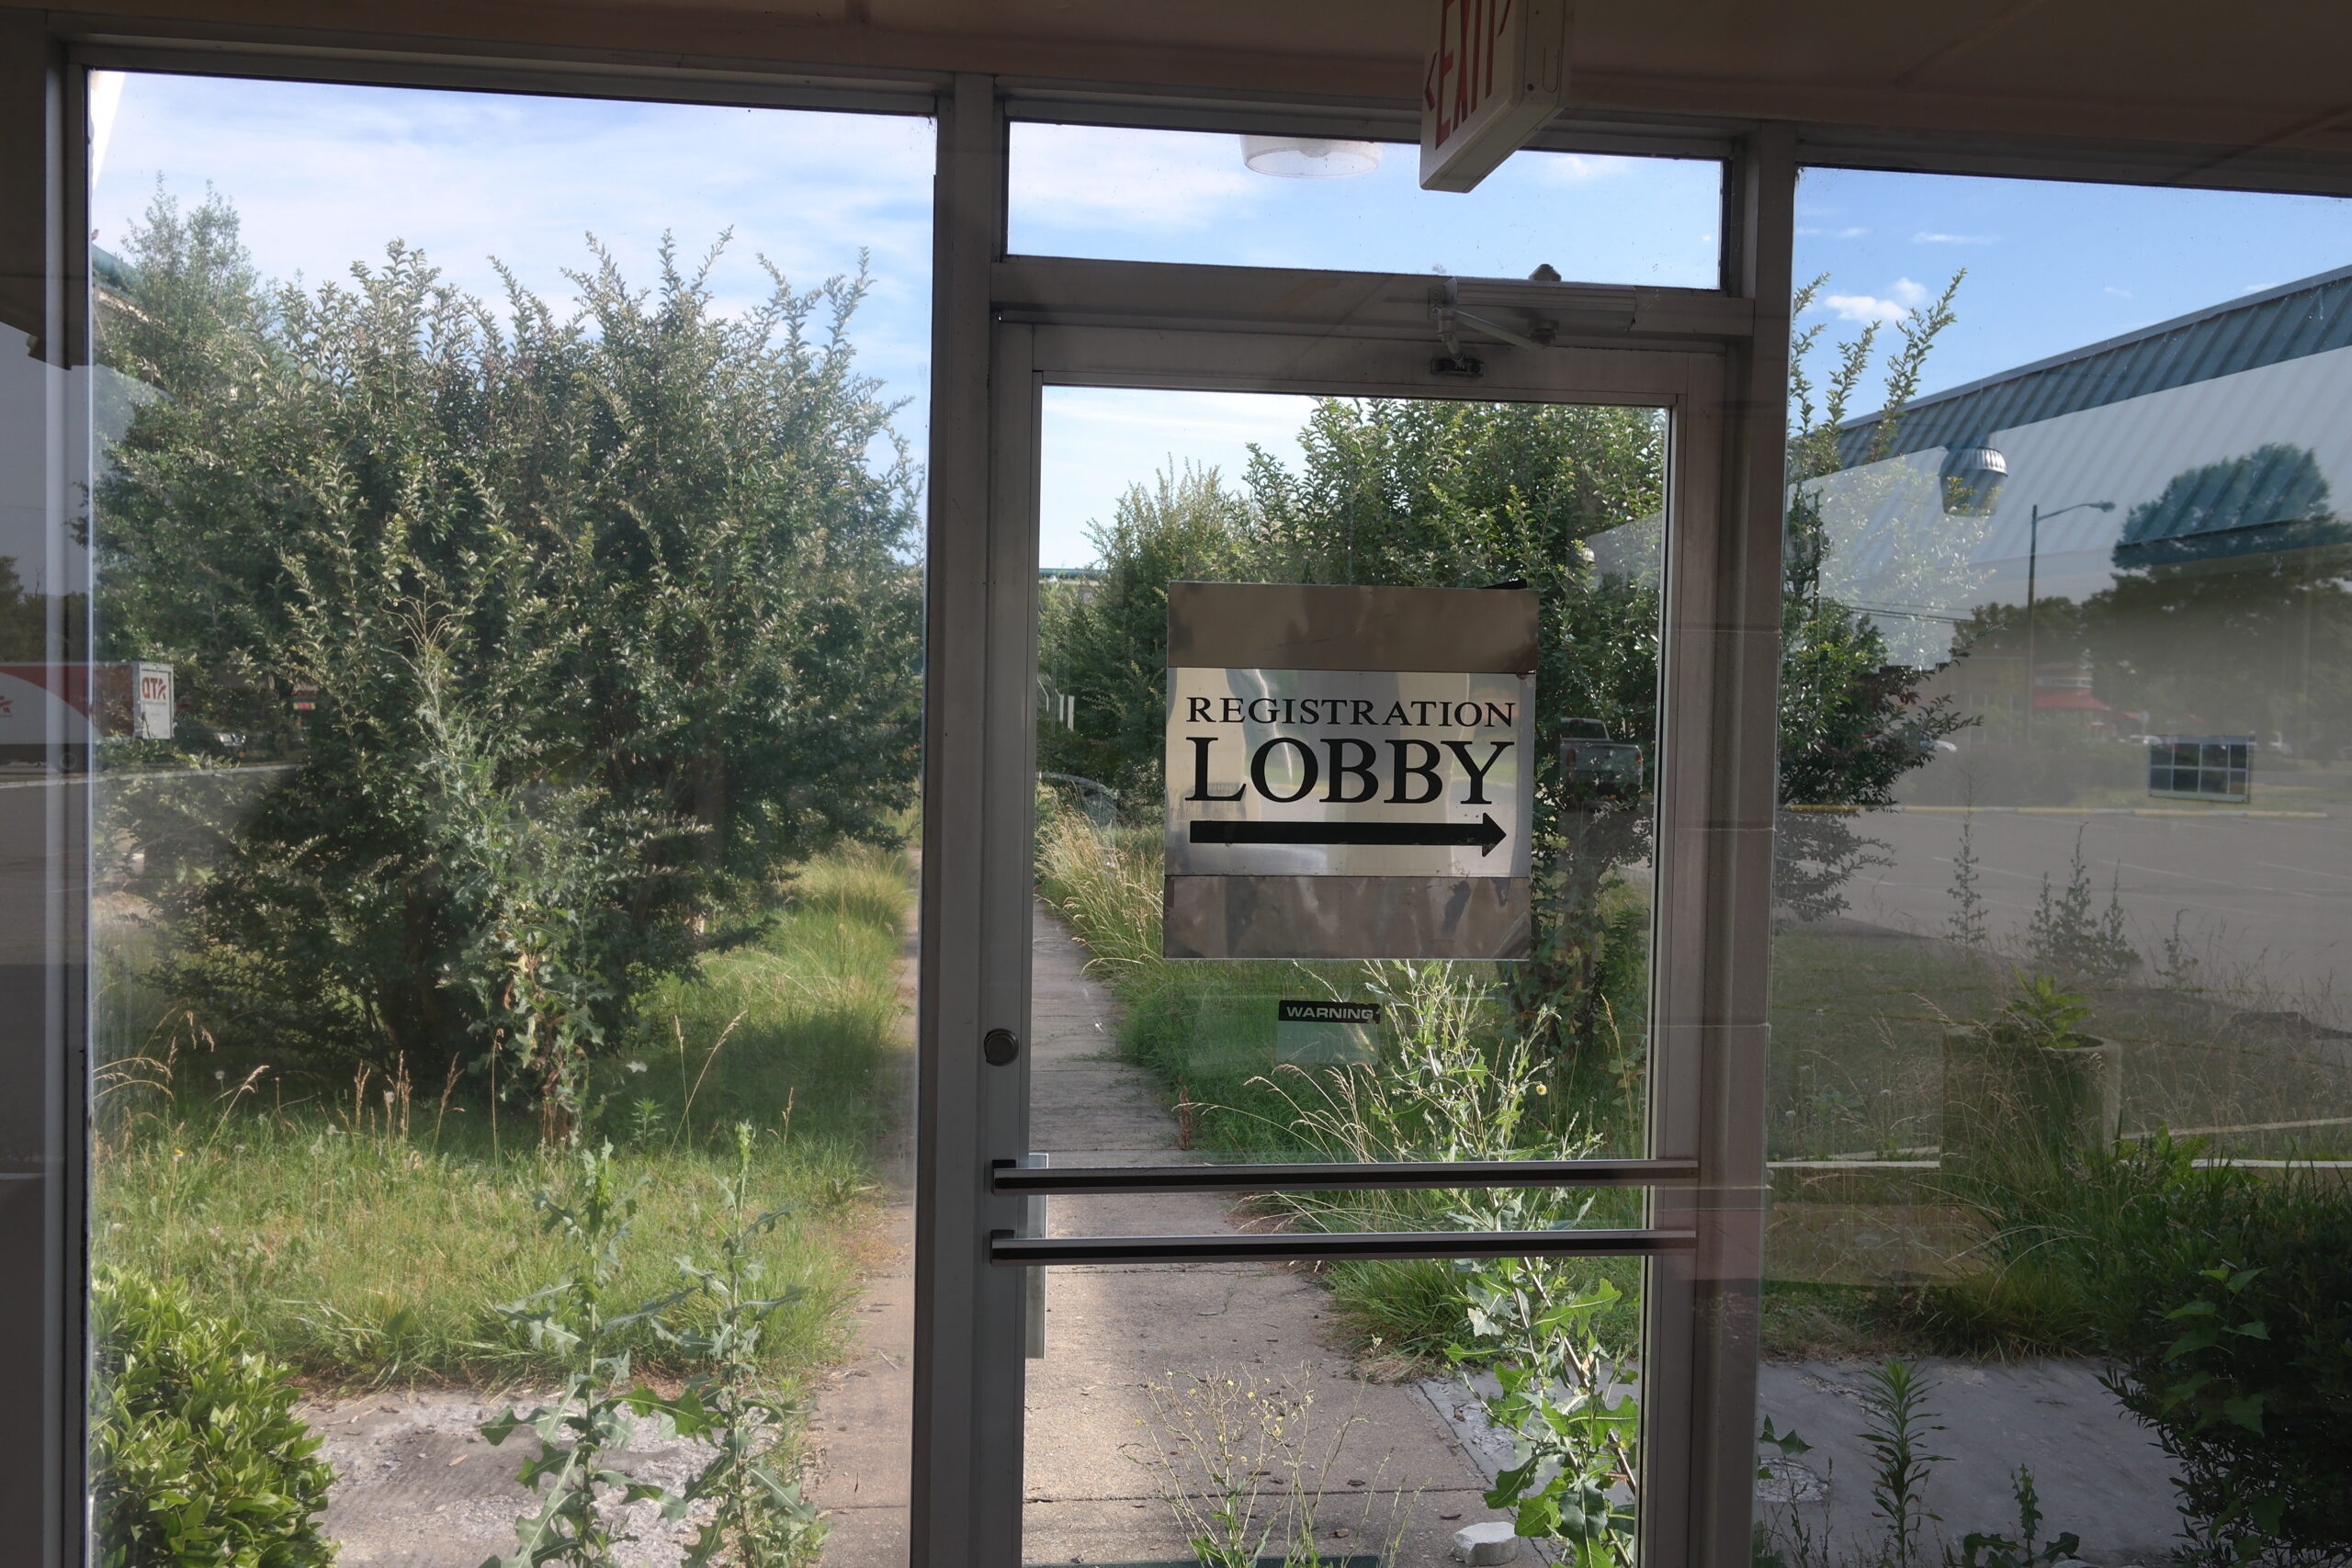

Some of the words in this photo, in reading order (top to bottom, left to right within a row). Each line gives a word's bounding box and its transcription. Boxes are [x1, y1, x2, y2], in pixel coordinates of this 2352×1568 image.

[1185, 697, 1516, 728] REGISTRATION
[1184, 737, 1515, 805] LOBBY
[1286, 1007, 1374, 1020] WARNING
